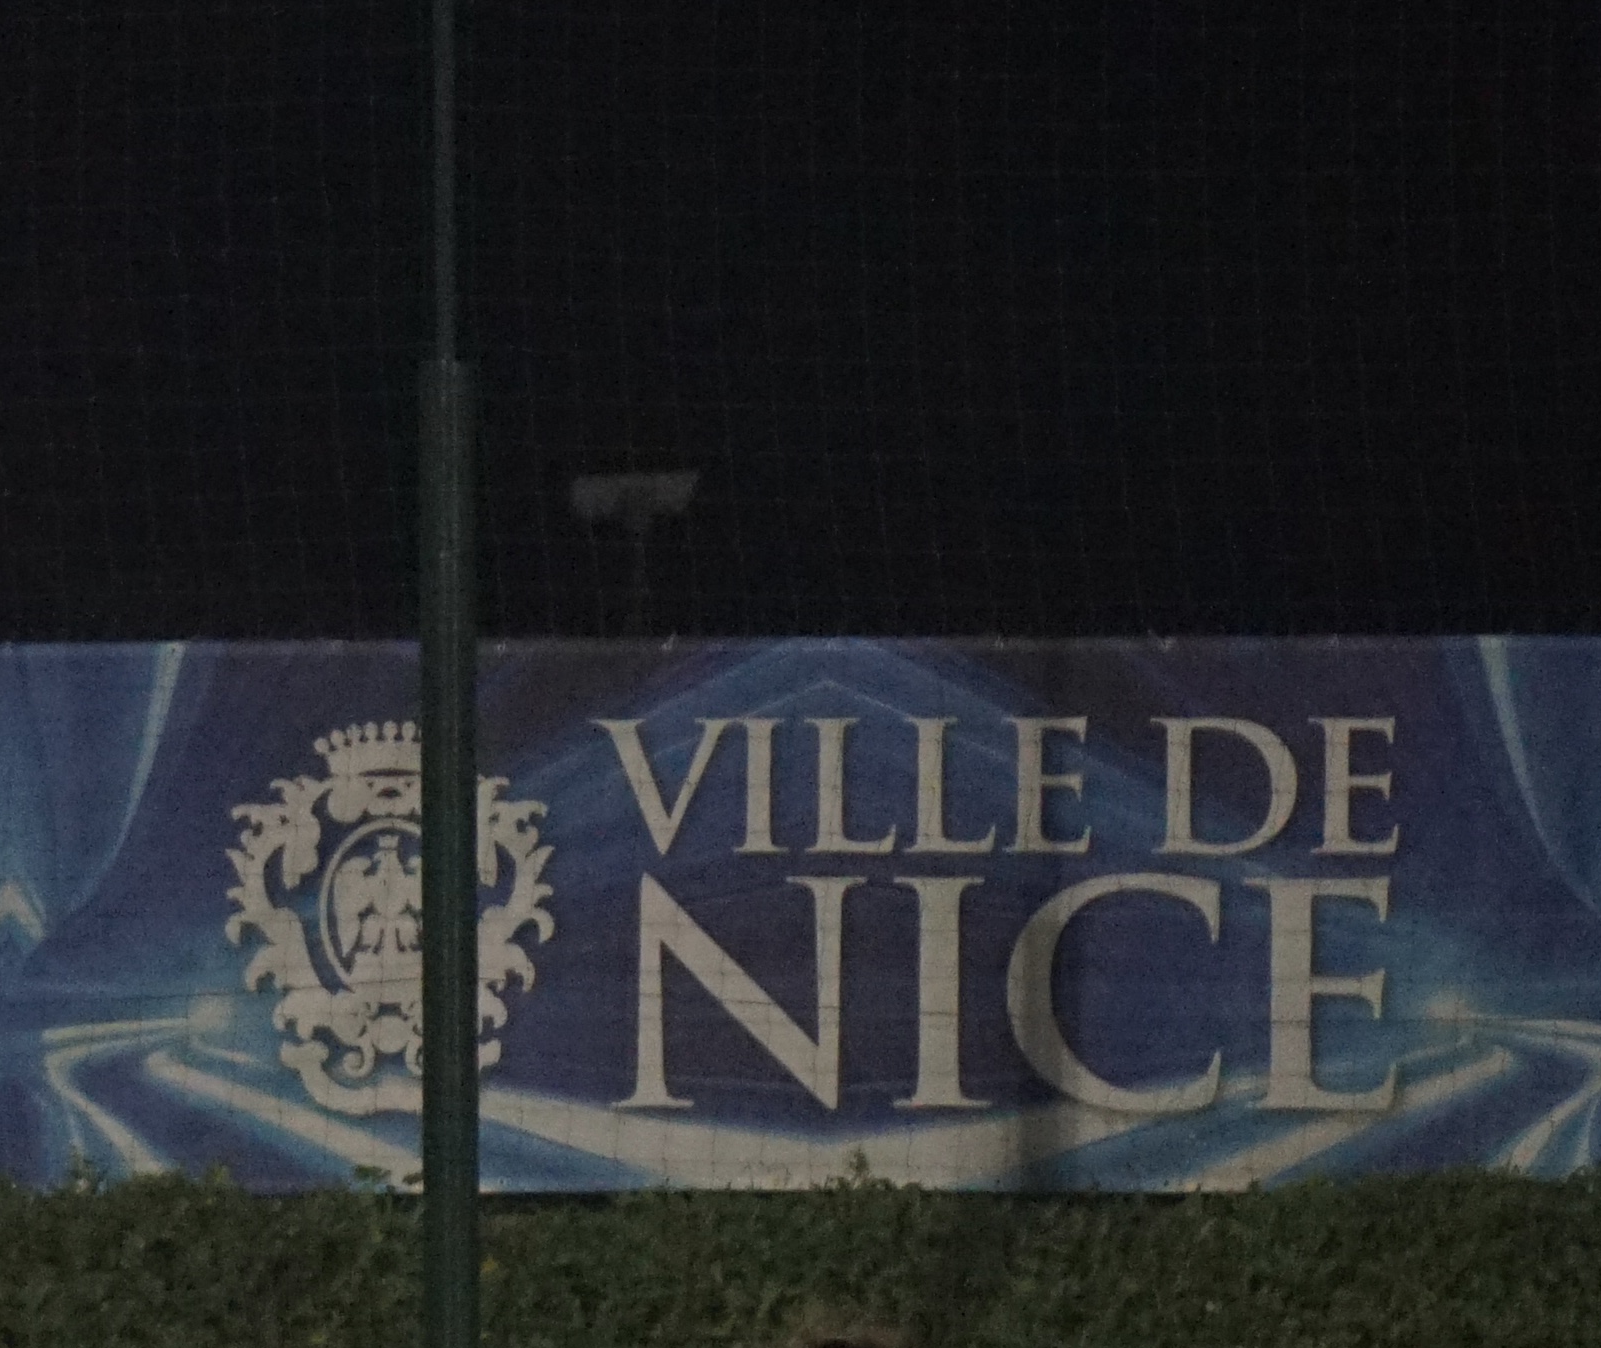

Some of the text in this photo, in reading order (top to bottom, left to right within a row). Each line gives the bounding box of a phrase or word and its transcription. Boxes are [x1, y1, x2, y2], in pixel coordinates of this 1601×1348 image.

[592, 716, 1400, 857] VILLE DE
[612, 872, 1402, 1112] NICE
